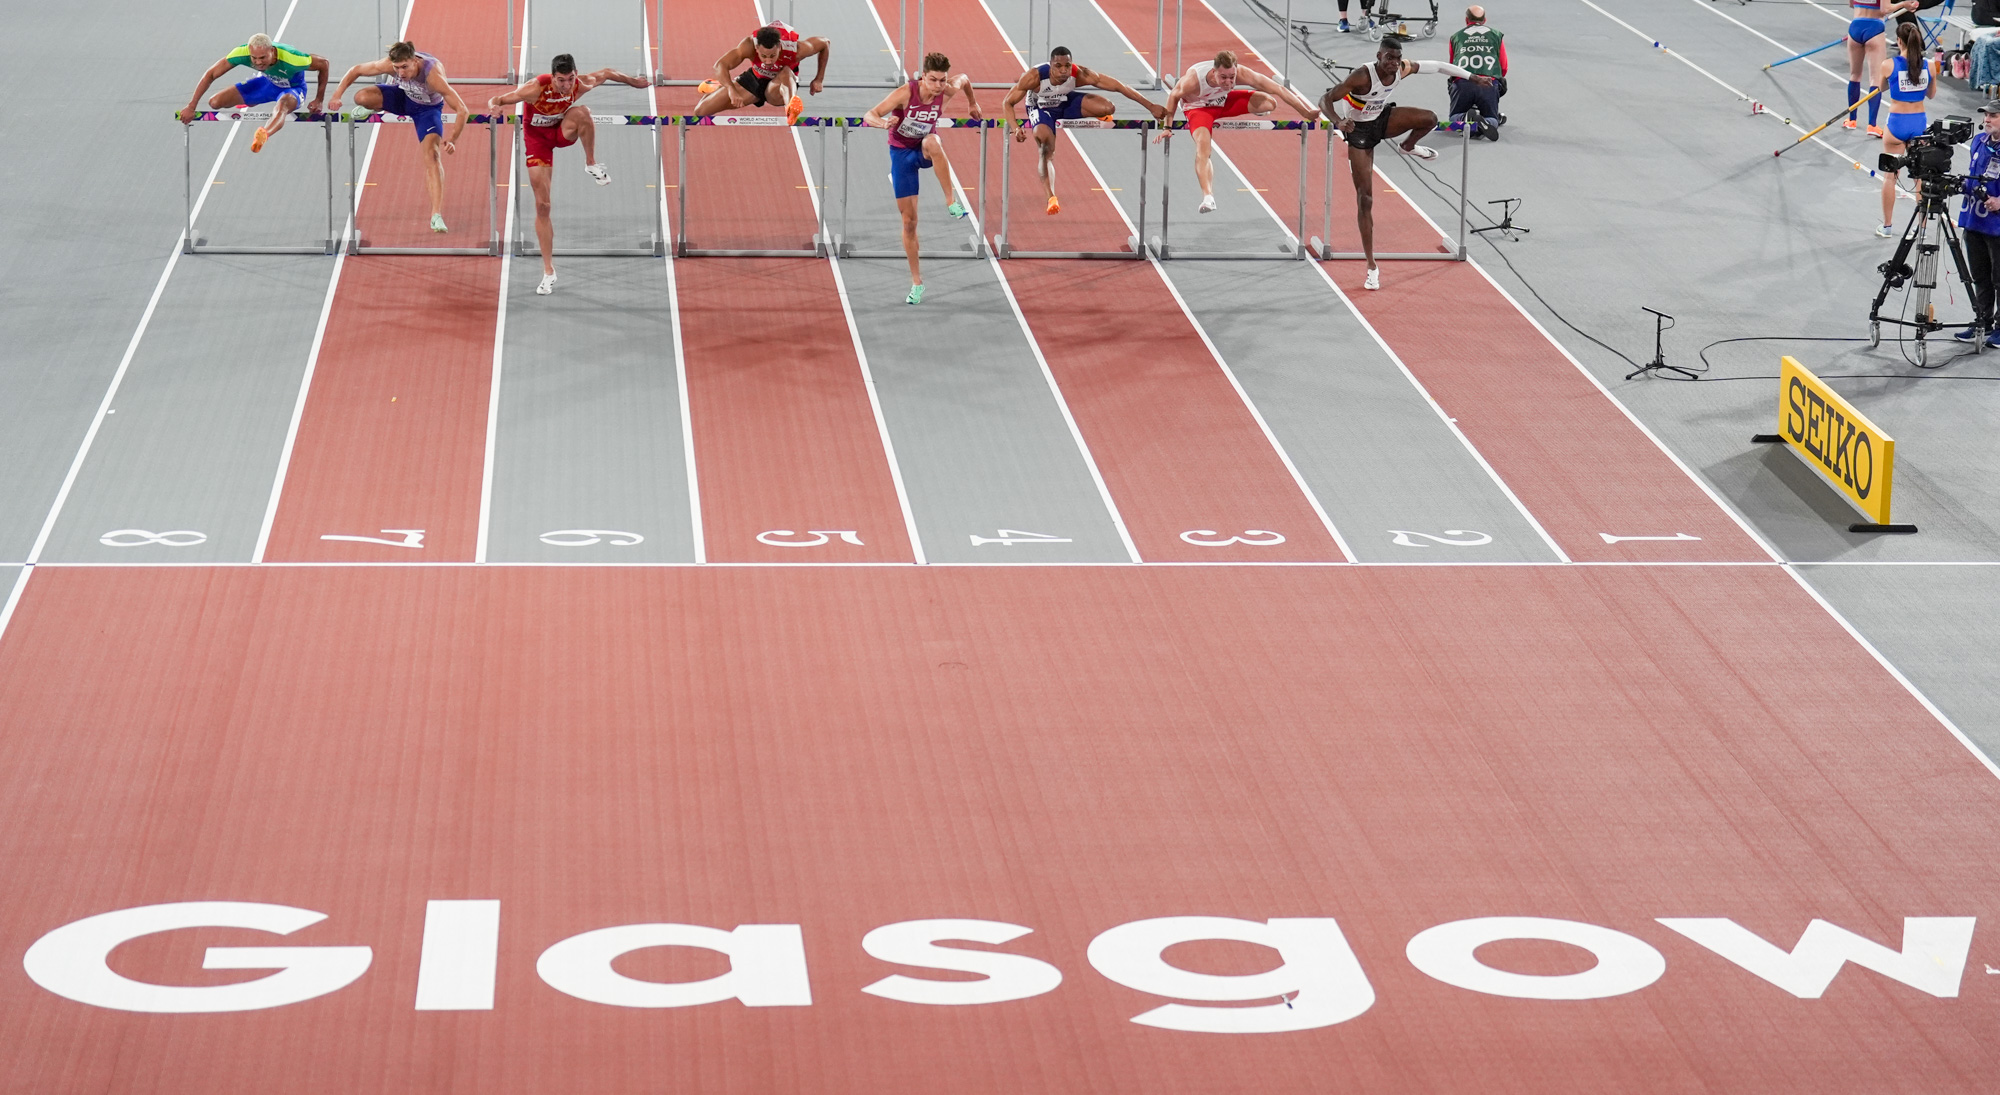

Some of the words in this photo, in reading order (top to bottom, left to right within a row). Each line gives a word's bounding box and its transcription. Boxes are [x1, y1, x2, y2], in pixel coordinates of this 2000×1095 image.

[1460, 46, 1494, 54] SONY
[1458, 54, 1496, 70] 009
[906, 110, 938, 121] USA
[1788, 376, 1872, 500] SEIKO
[99, 529, 207, 547] 8
[320, 529, 425, 548] 7
[539, 529, 644, 546] 6
[756, 530, 864, 547] 5
[969, 529, 1073, 546] 4
[1179, 530, 1286, 546] 3
[1387, 529, 1493, 547] 2
[1599, 532, 1702, 544] 1
[23, 900, 1976, 1034] Glasgow
